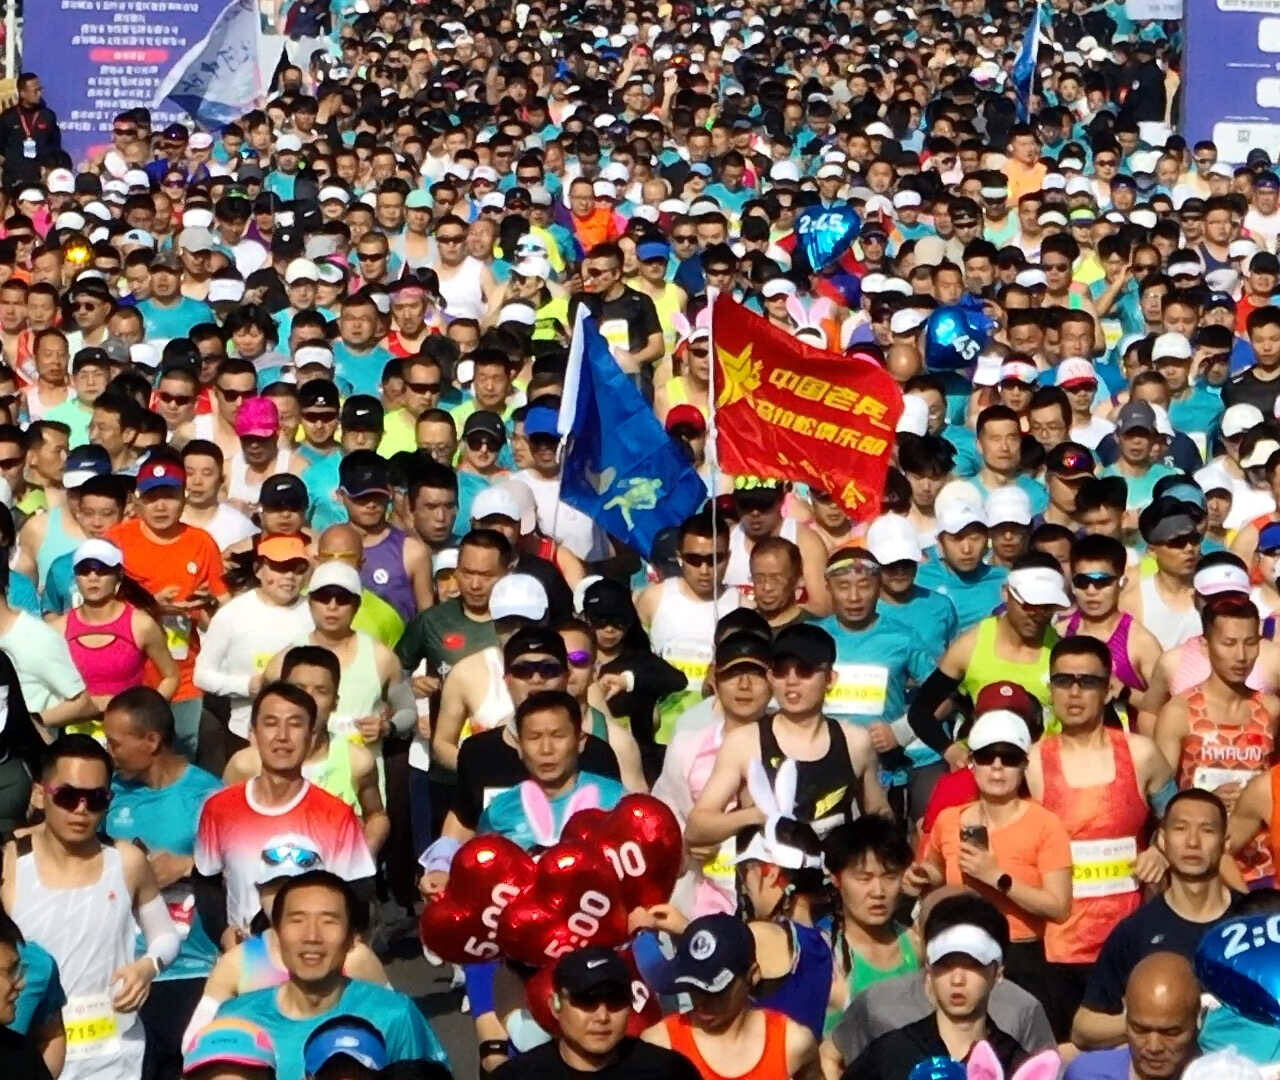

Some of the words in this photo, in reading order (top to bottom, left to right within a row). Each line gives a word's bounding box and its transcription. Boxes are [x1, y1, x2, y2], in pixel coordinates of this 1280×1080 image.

[799, 213, 844, 234] 2:45
[769, 367, 889, 431] 中国老兵
